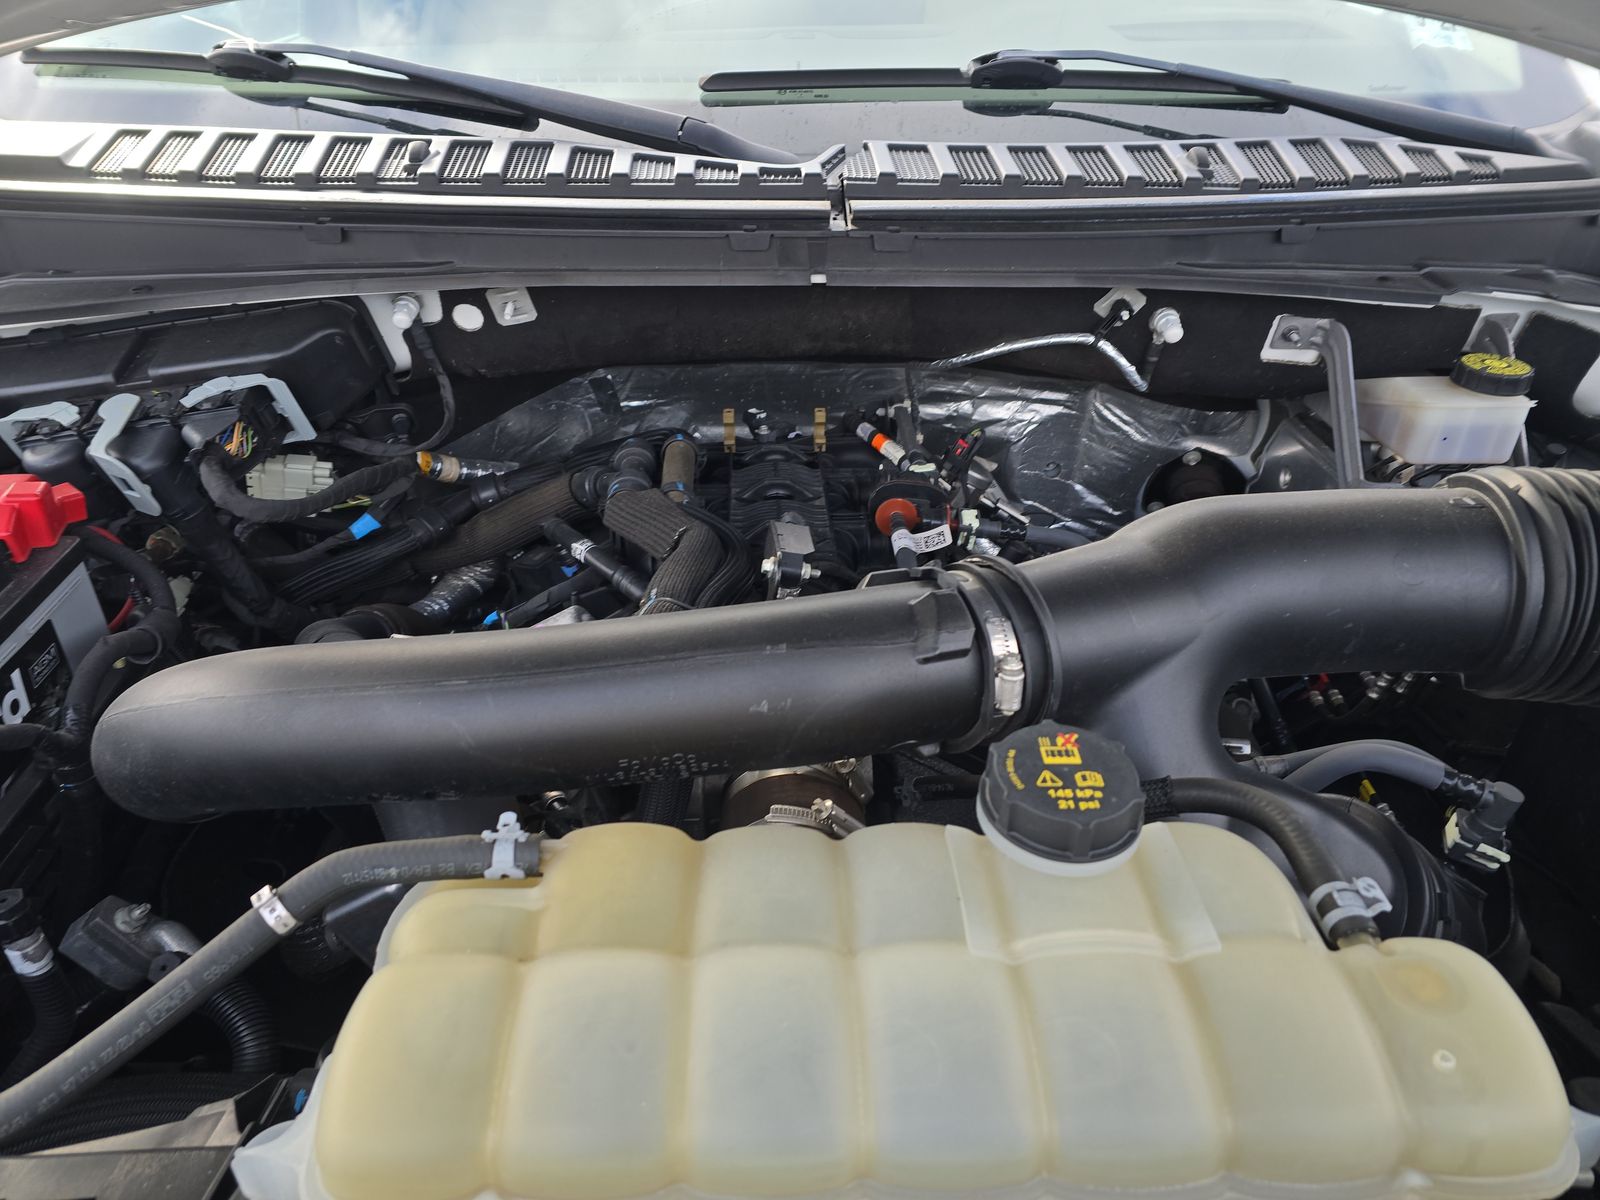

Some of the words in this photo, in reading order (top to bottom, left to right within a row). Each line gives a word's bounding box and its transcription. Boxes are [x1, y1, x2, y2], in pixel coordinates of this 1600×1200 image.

[0, 667, 32, 725] d
[1075, 788, 1104, 799] kPa
[1057, 799, 1075, 810] 21
[1078, 799, 1101, 811] psi
